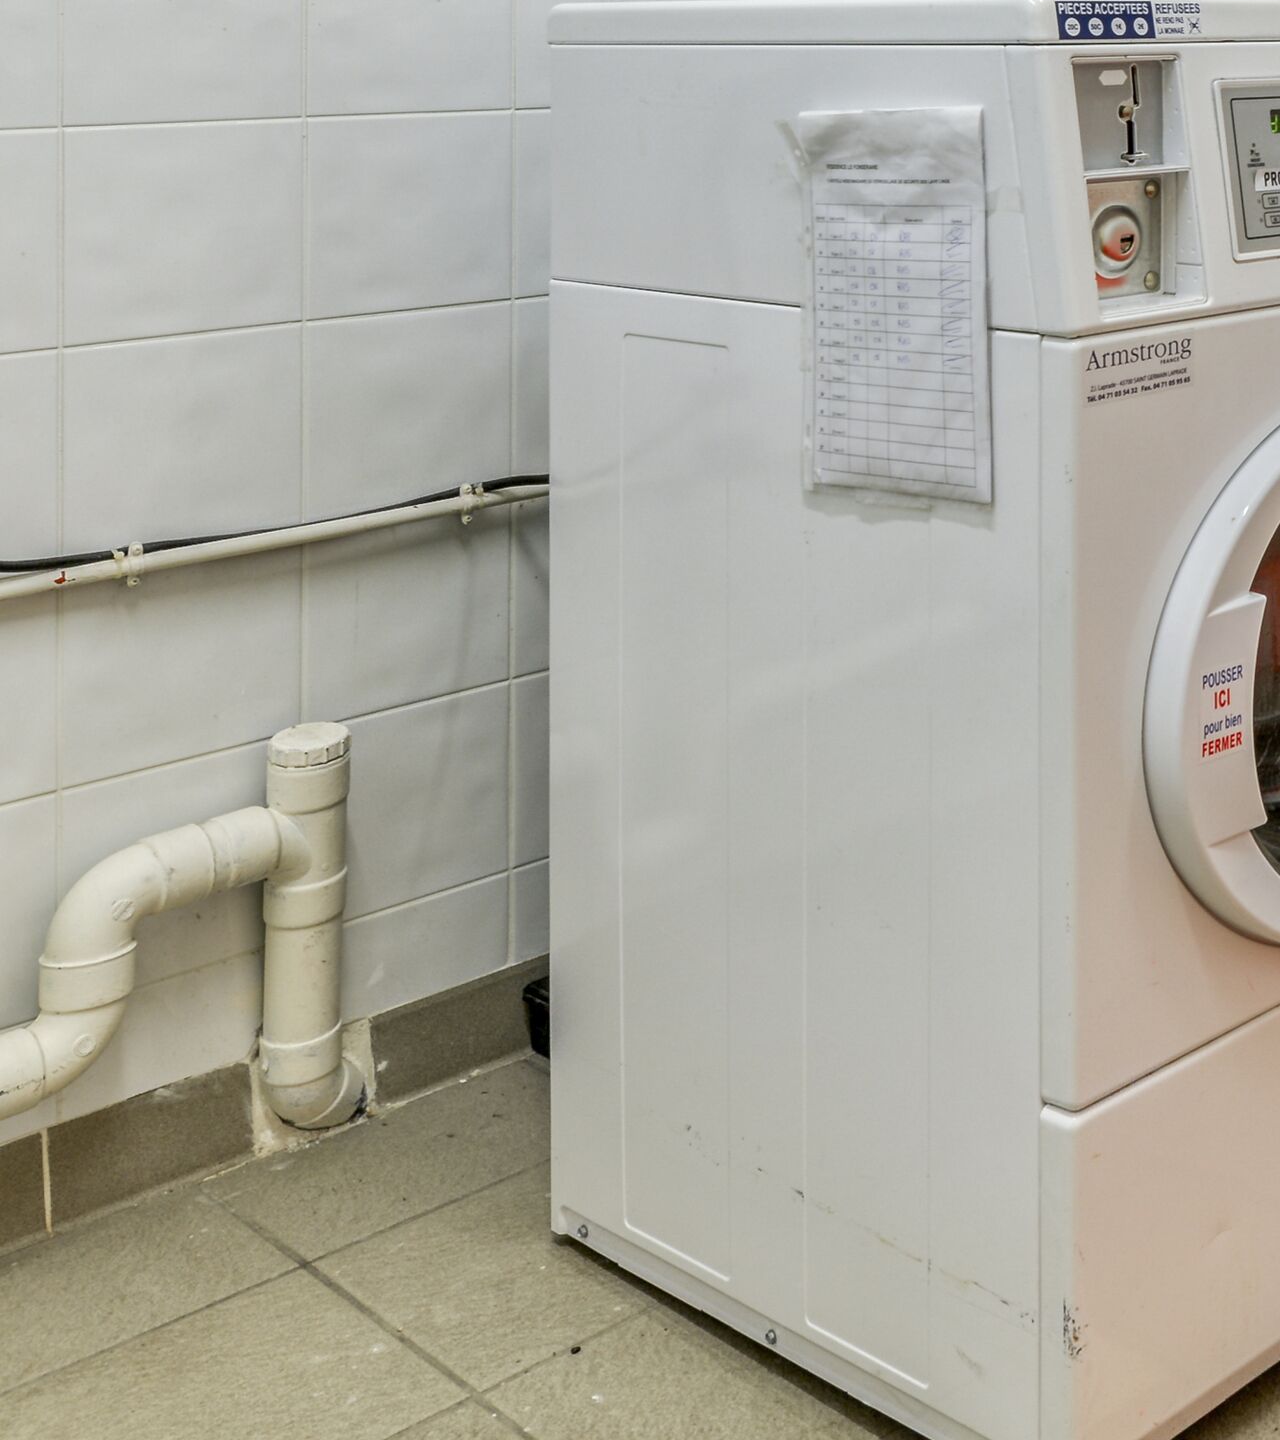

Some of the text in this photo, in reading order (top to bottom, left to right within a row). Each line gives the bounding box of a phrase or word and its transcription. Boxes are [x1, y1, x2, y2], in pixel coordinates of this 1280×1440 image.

[1058, 2, 1200, 15] PIECES ACCEPTEES REFUSEES
[1085, 338, 1192, 372] Armstrong
[1202, 665, 1243, 689] POUSSER
[1214, 688, 1231, 709] ICI
[1204, 714, 1242, 739] pour bien
[1202, 731, 1242, 758] FERMER
